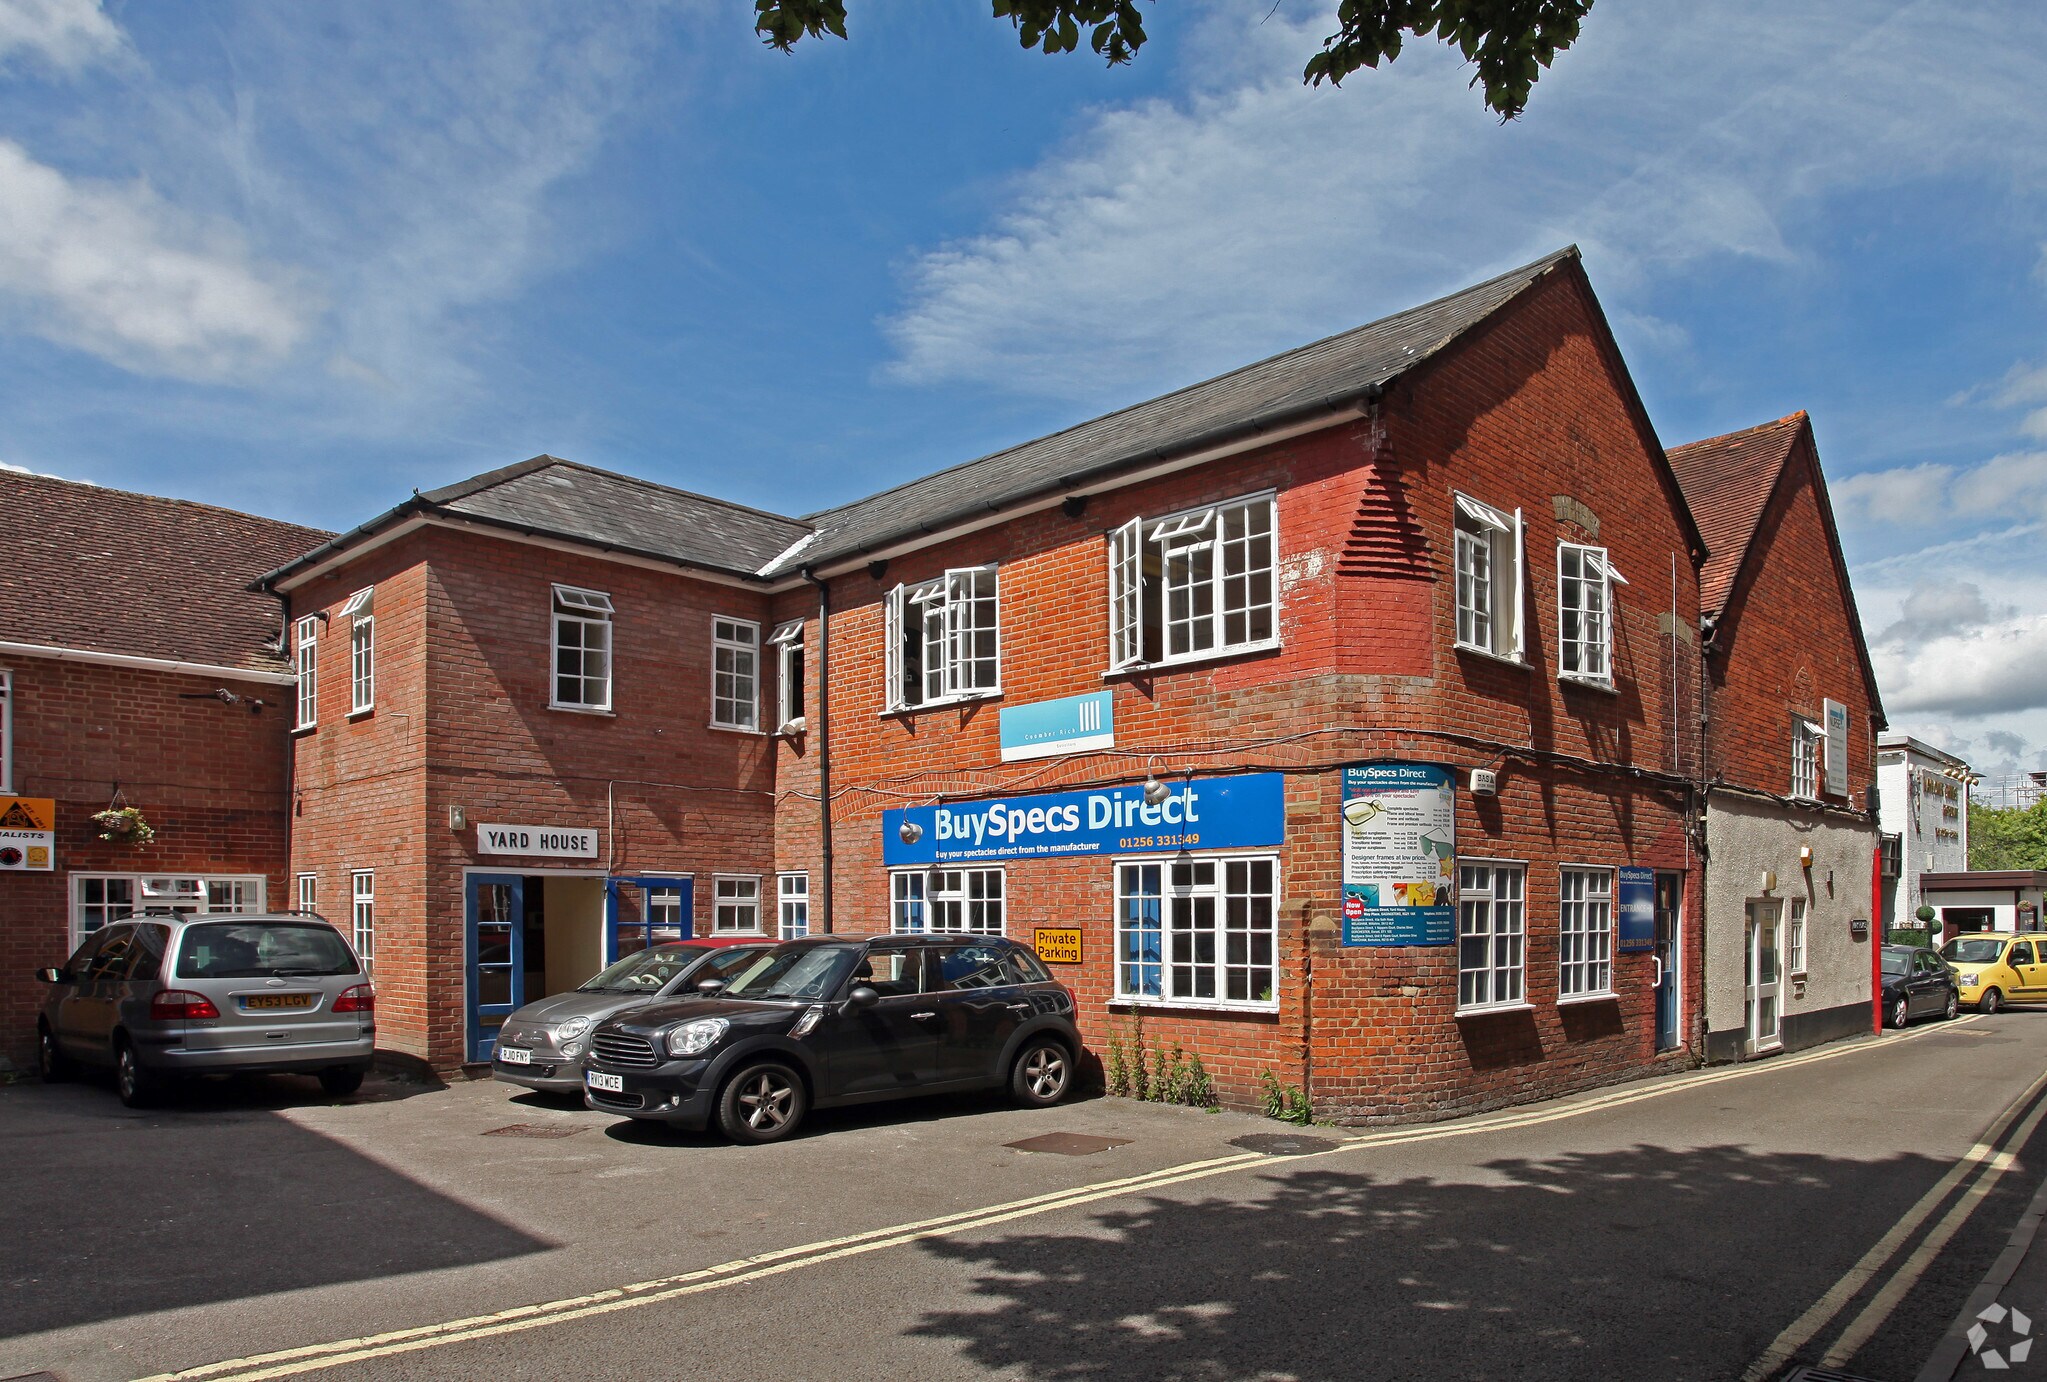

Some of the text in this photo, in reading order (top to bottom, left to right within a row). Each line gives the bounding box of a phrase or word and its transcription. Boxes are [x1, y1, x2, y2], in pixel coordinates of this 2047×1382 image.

[1024, 731, 1056, 740] Coomber
[1348, 768, 1426, 779] BuySpecs Direct
[935, 787, 1199, 845] BuySpecs Direct
[488, 831, 588, 851] YARD HOUSE
[1119, 834, 1200, 848] 01256 331349
[935, 842, 1100, 860] Buy your spectacles direct from the manufacturer
[1620, 871, 1652, 880] BuySpecs Direct
[1620, 904, 1646, 912] ENTRANCE
[1038, 932, 1076, 944] Private
[1038, 946, 1078, 960] Parking
[248, 994, 308, 1008] EY53 LGV
